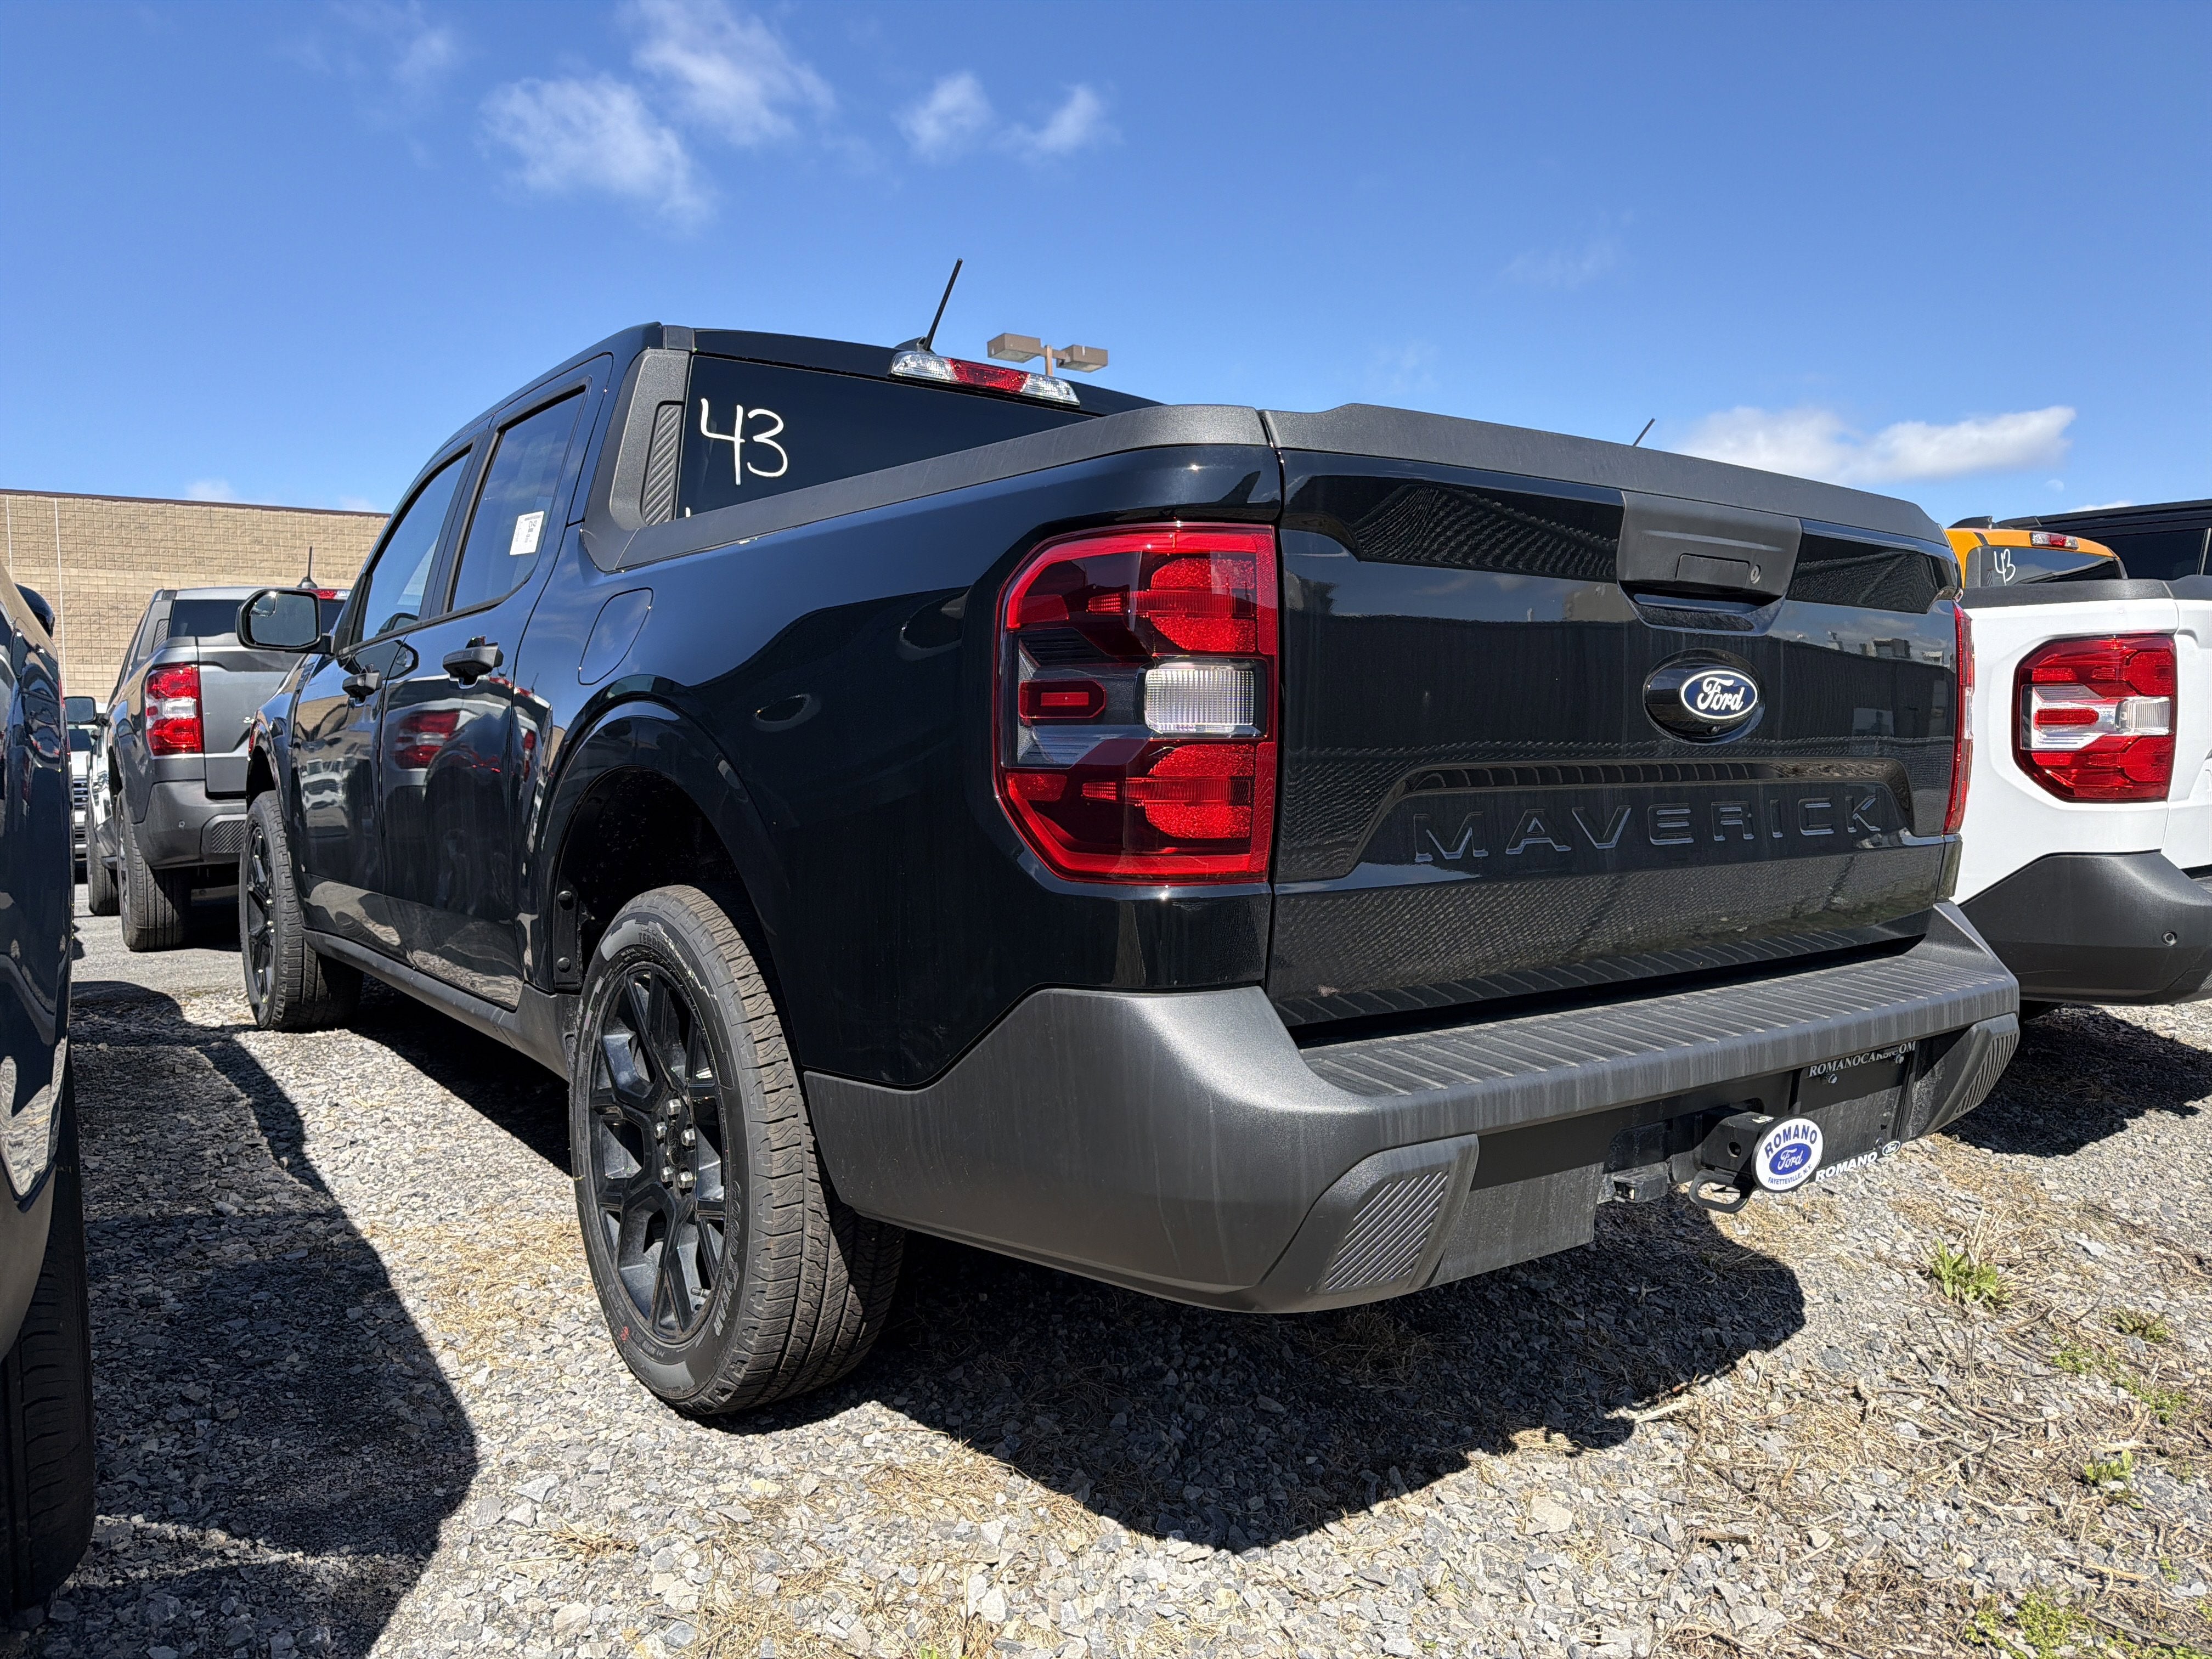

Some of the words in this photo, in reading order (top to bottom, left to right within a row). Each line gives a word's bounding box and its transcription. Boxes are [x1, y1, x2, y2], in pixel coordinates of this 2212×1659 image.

[700, 398, 788, 486] 43
[1994, 548, 2016, 586] 43
[1697, 677, 1744, 711] Ford
[1413, 794, 1882, 863] MAVERICK
[1764, 1124, 1818, 1159] ROMANO
[1778, 1148, 1804, 1171] Ford
[1815, 1152, 1877, 1182] ROMANO
[713, 1180, 741, 1337] GOODYEAR
